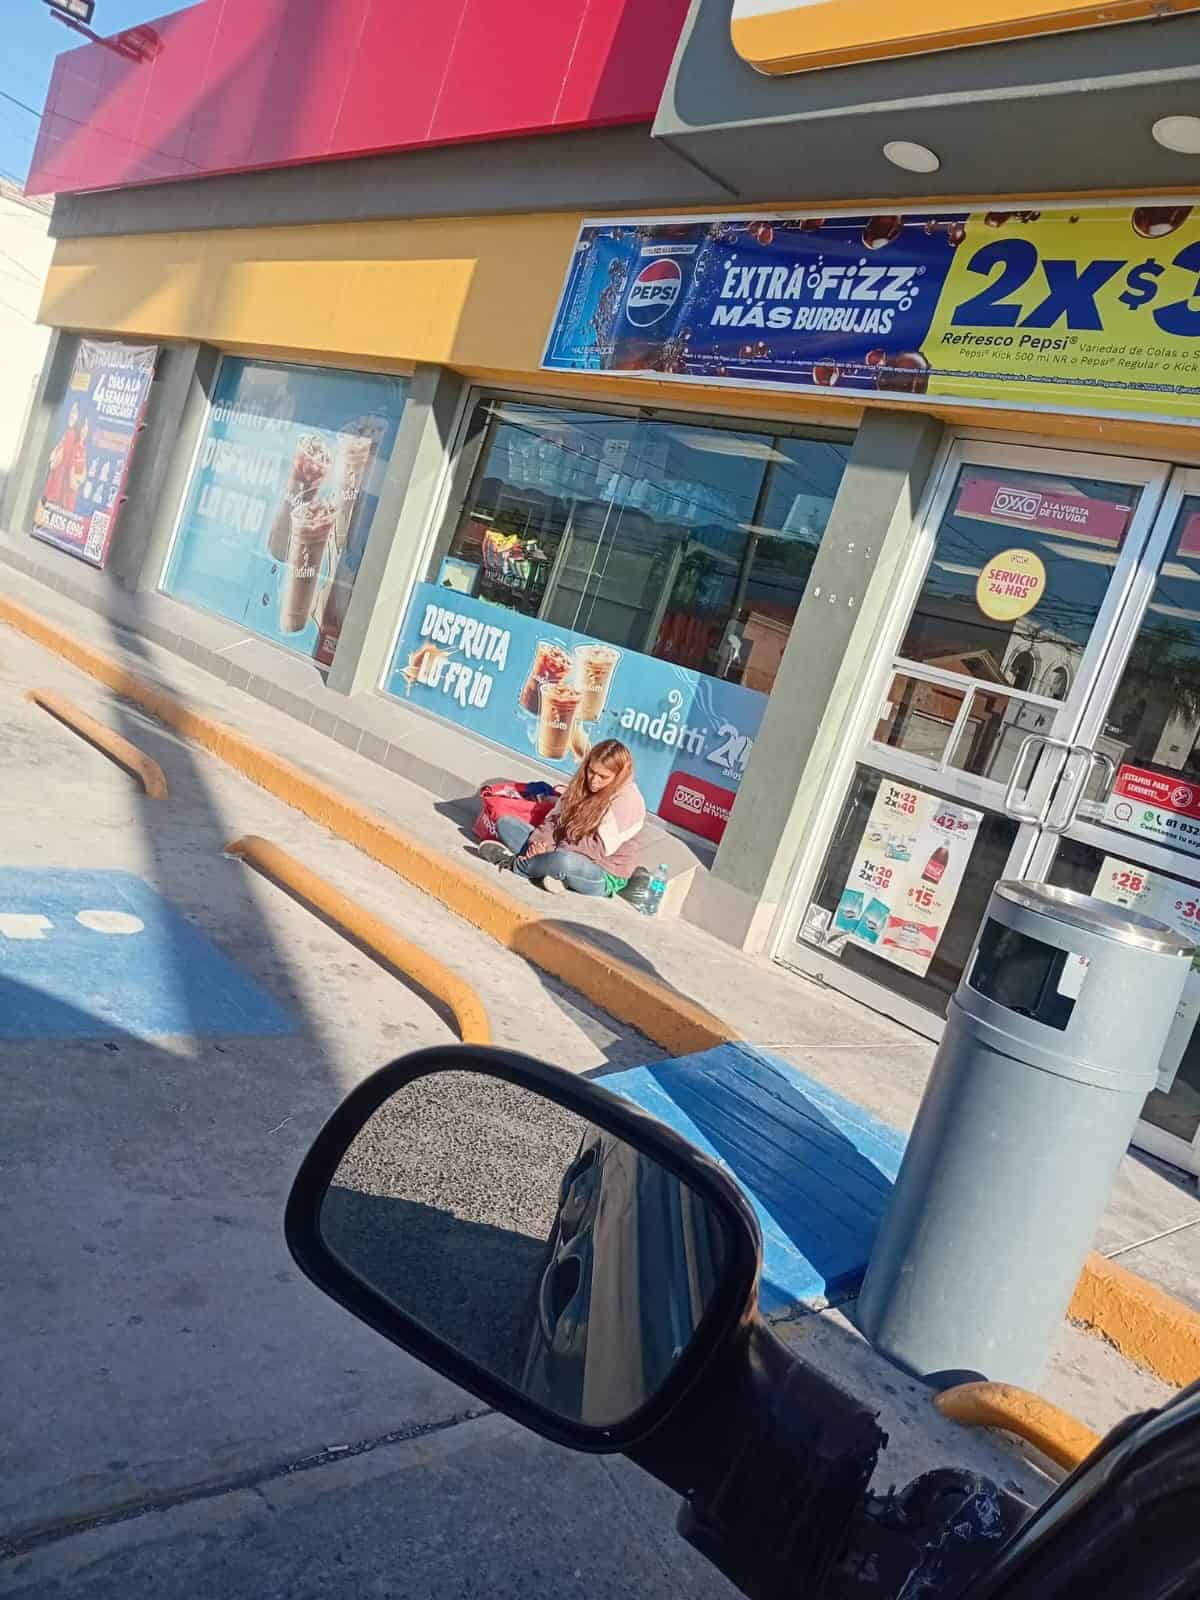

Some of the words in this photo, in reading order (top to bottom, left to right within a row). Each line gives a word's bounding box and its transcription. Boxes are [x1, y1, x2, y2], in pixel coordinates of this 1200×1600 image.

[631, 285, 678, 300] PEPSI
[720, 265, 804, 299] EXTRA
[710, 301, 793, 329] MÁS
[792, 306, 895, 334] BURBUJAS
[941, 332, 1013, 347] Refresco
[1080, 343, 1126, 355] Variedad
[1129, 345, 1143, 355] de
[1146, 347, 1177, 358] Colas
[992, 352, 1011, 361] Kick
[1015, 351, 1033, 361] 500
[1118, 358, 1158, 370] Regular
[1174, 362, 1197, 372] Kick
[993, 491, 1039, 517] OXXO
[1050, 502, 1059, 510] LA
[1060, 504, 1088, 515] VUELTA
[1040, 508, 1050, 517] DE
[1052, 510, 1064, 520] TU
[1065, 512, 1087, 524] VIDA
[988, 568, 1039, 588] SERVICIO
[989, 583, 1002, 595] 24
[1005, 584, 1029, 599] HRS
[420, 604, 511, 671] DISFRUTA
[417, 651, 449, 688] LO
[443, 661, 493, 708] FRÍO
[620, 706, 707, 755] andatti
[674, 787, 704, 812] OXXO
[1180, 822, 1200, 836] 832
[1112, 872, 1142, 891] $28
[907, 887, 934, 906] $15
